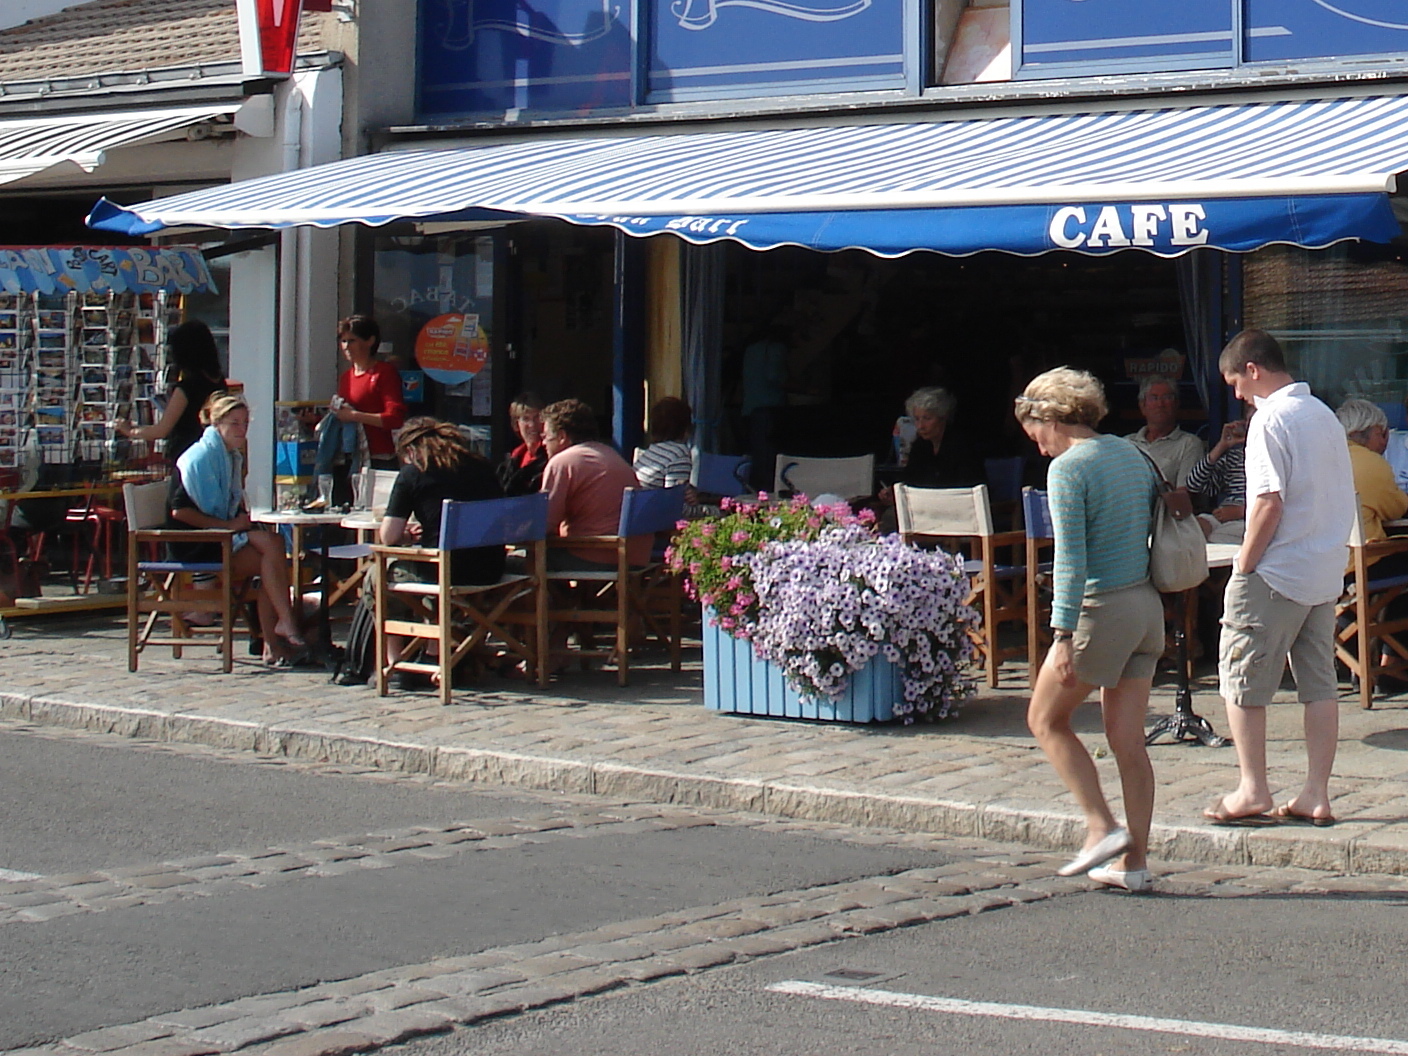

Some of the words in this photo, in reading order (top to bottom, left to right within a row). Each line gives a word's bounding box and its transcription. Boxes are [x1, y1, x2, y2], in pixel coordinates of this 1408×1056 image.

[1050, 204, 1209, 249] CAFE
[127, 247, 209, 287] BART
[1129, 361, 1178, 374] RAPIDO
